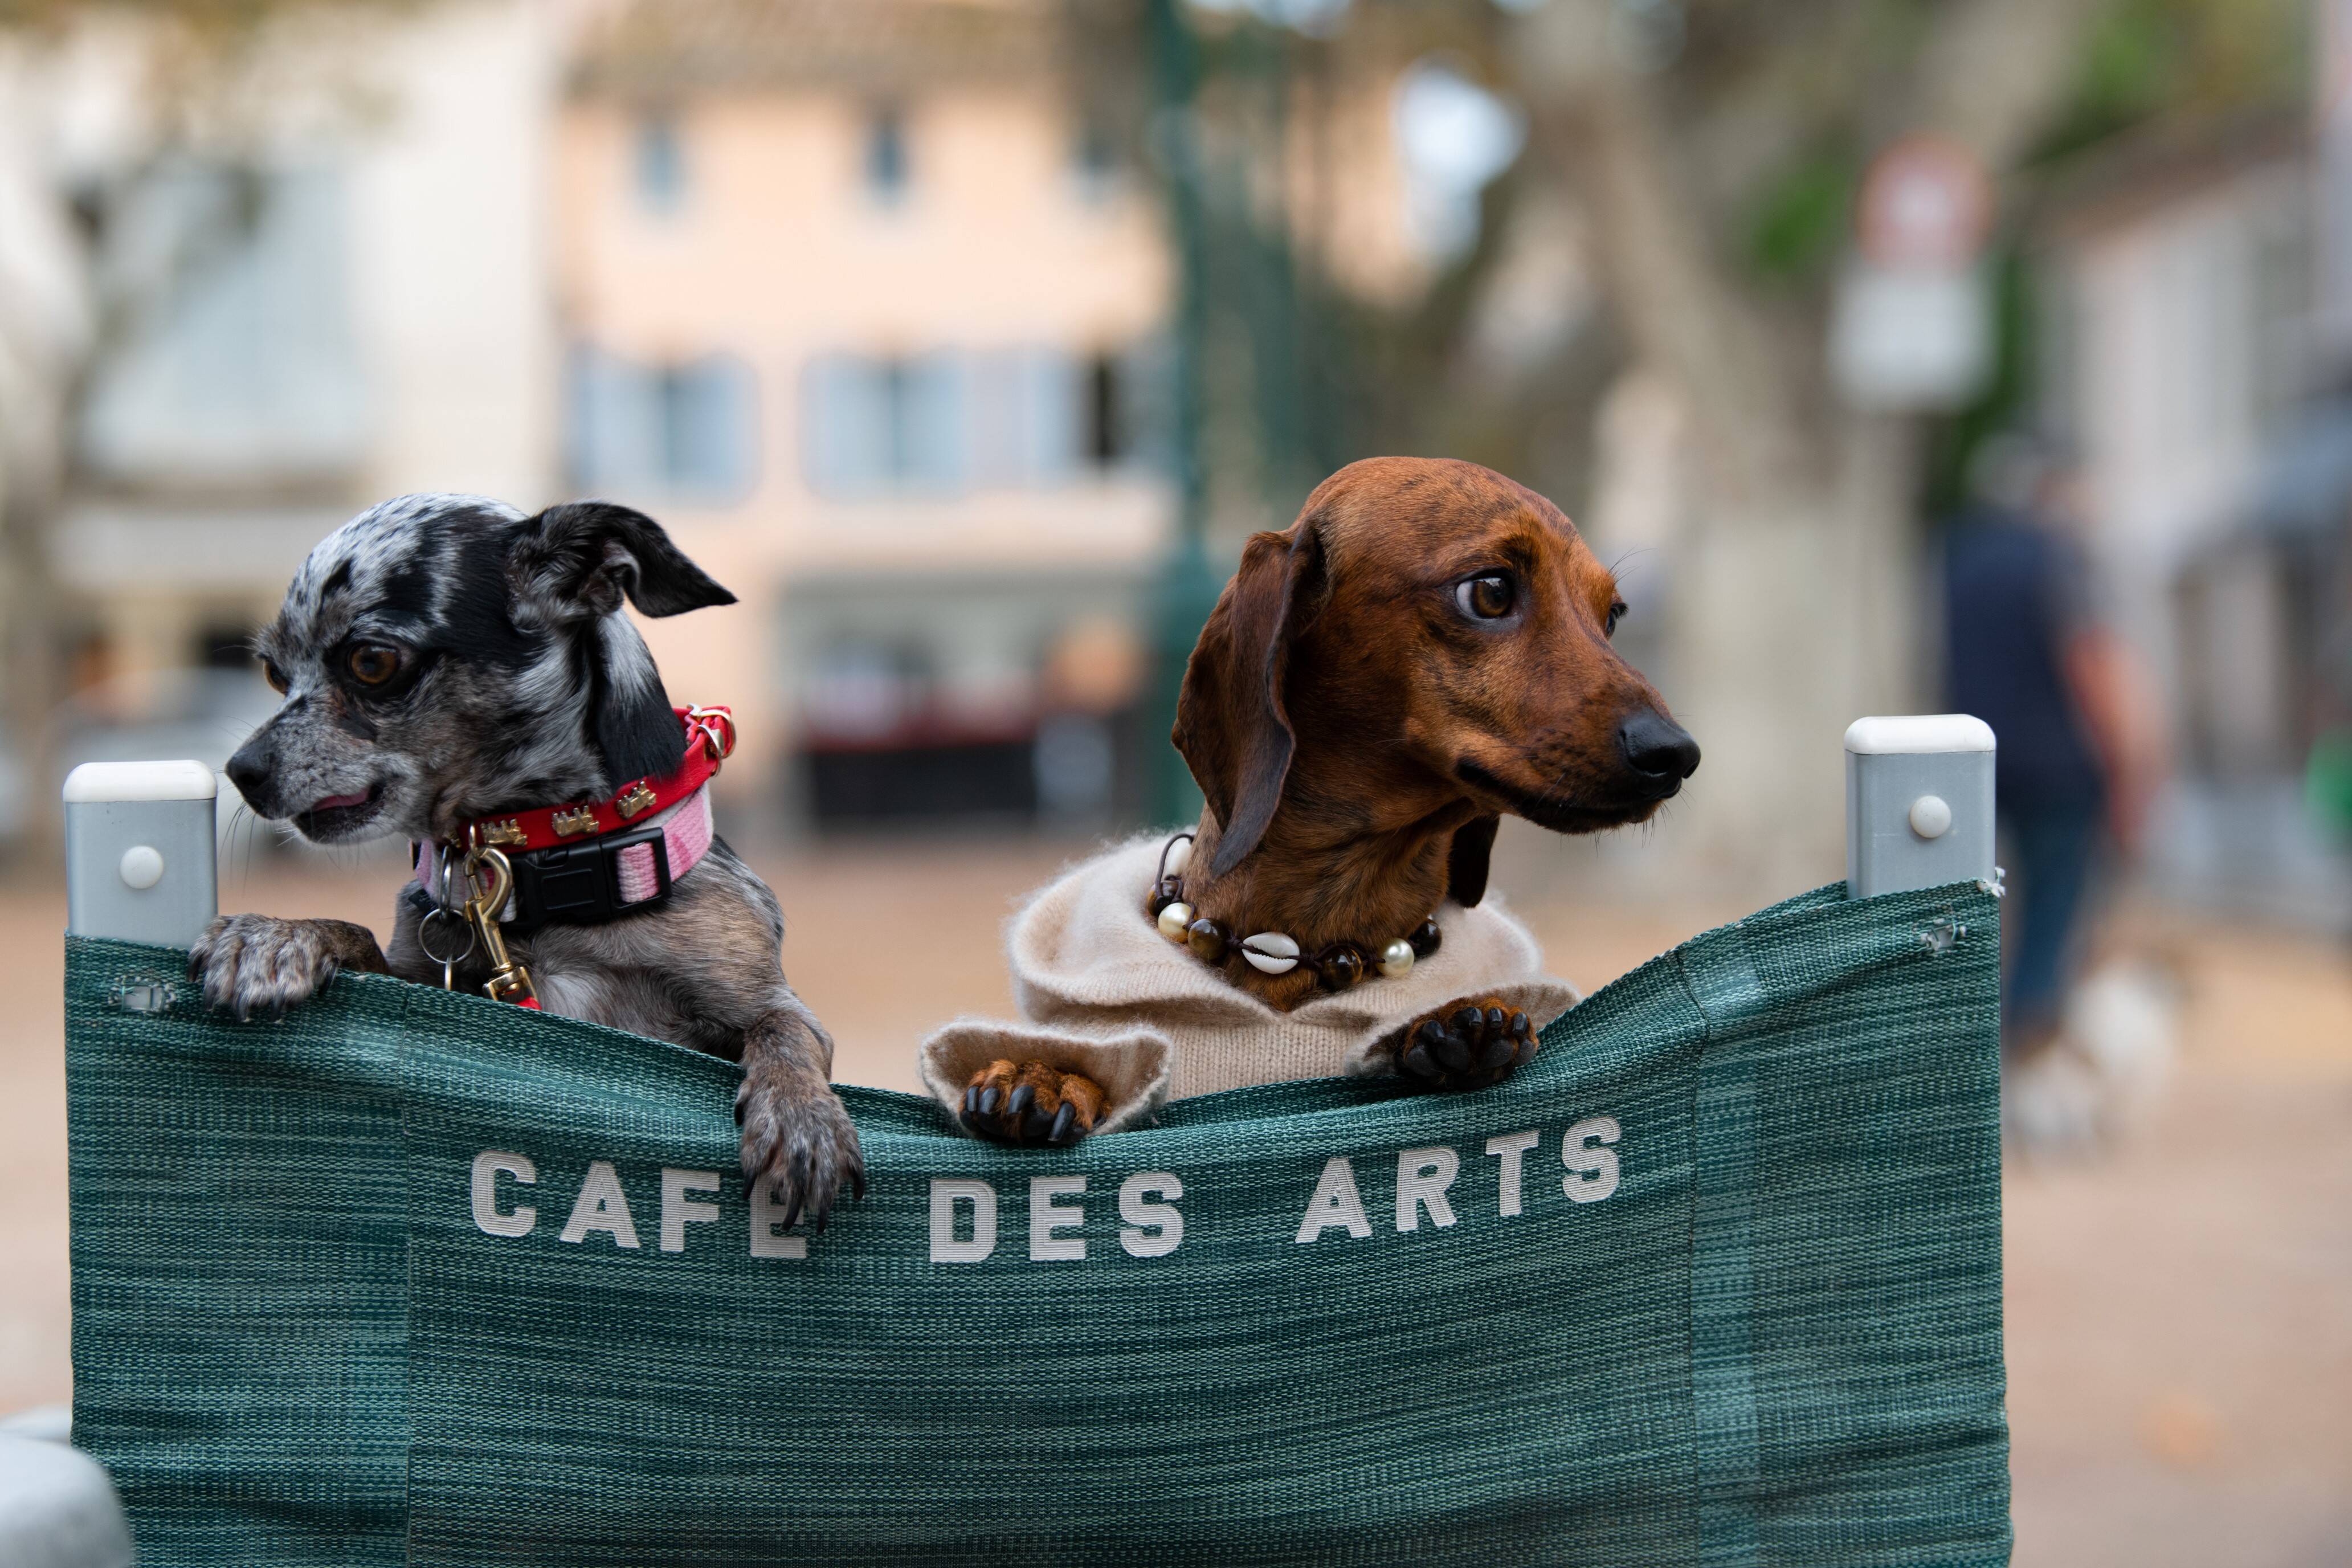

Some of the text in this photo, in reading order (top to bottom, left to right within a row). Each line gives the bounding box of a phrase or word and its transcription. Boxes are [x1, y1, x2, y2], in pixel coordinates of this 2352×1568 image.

[471, 1116, 1622, 1263] CAFE DES ARTS
